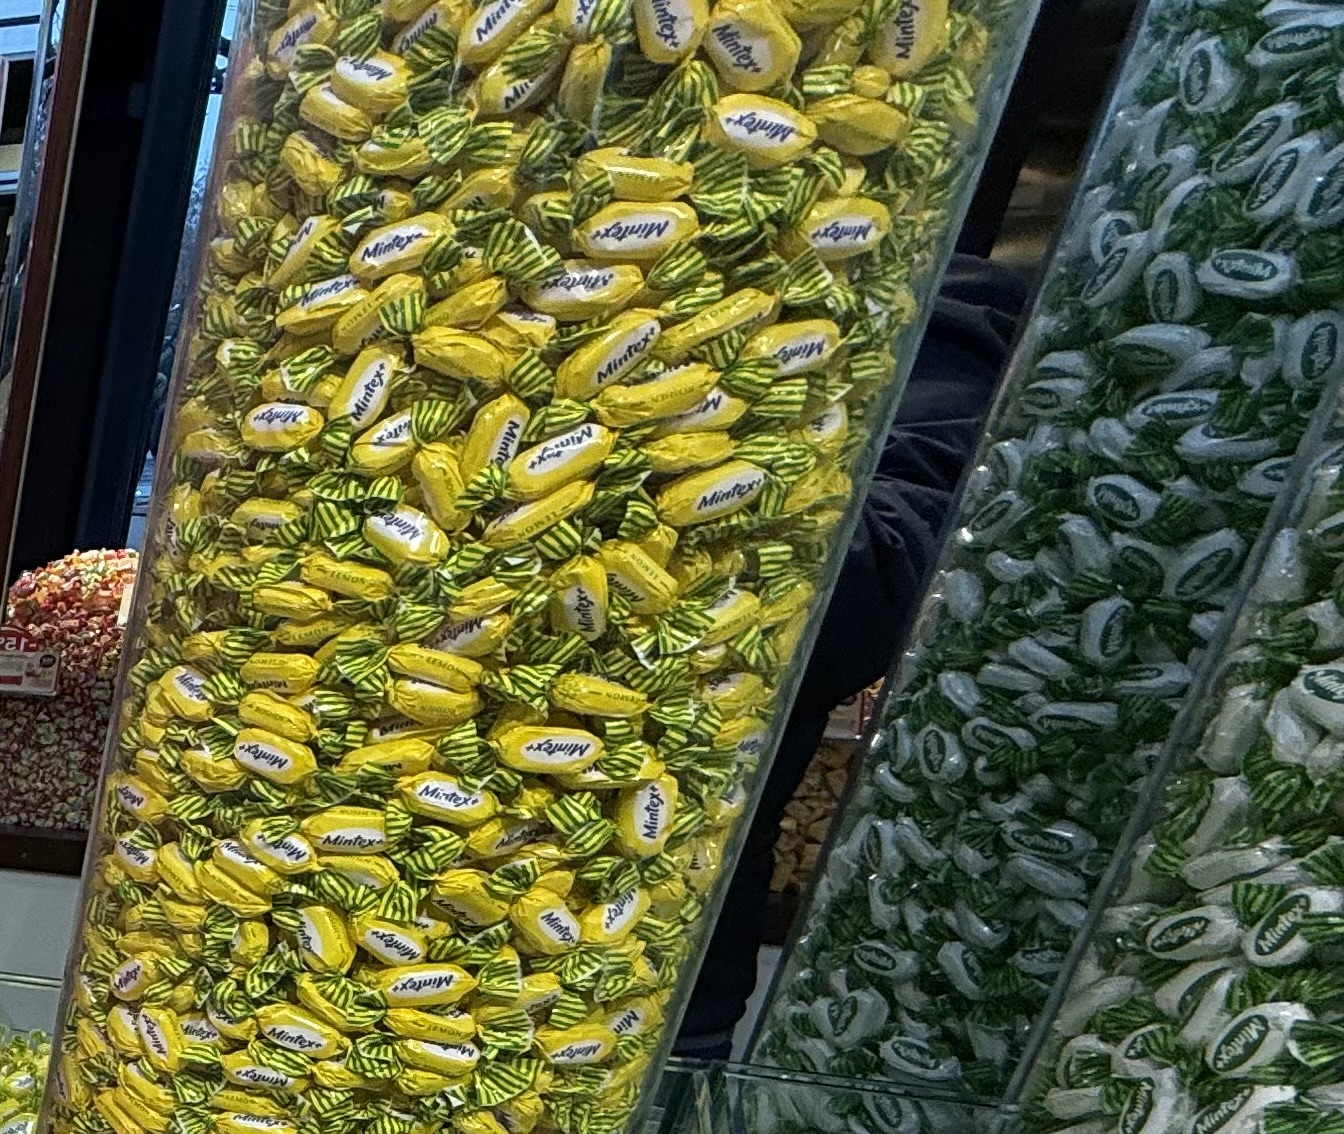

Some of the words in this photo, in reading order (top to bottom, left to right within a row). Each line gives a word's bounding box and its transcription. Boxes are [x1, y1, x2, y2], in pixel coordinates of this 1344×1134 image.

[715, 26, 761, 73] Mintex+
[727, 111, 798, 142] Mintex+
[592, 221, 669, 241] Mintex+
[362, 231, 424, 260] Mintex+
[597, 327, 656, 383] Mintex+
[697, 477, 761, 510] Mintex+
[239, 743, 288, 769] Mintex+
[526, 739, 590, 756] Mintex+
[418, 785, 478, 806] Mintex+
[643, 785, 664, 839] Mintex+
[323, 835, 383, 847] Mintex+
[393, 974, 453, 992] Mintex+
[268, 1030, 322, 1049] Mintex+
